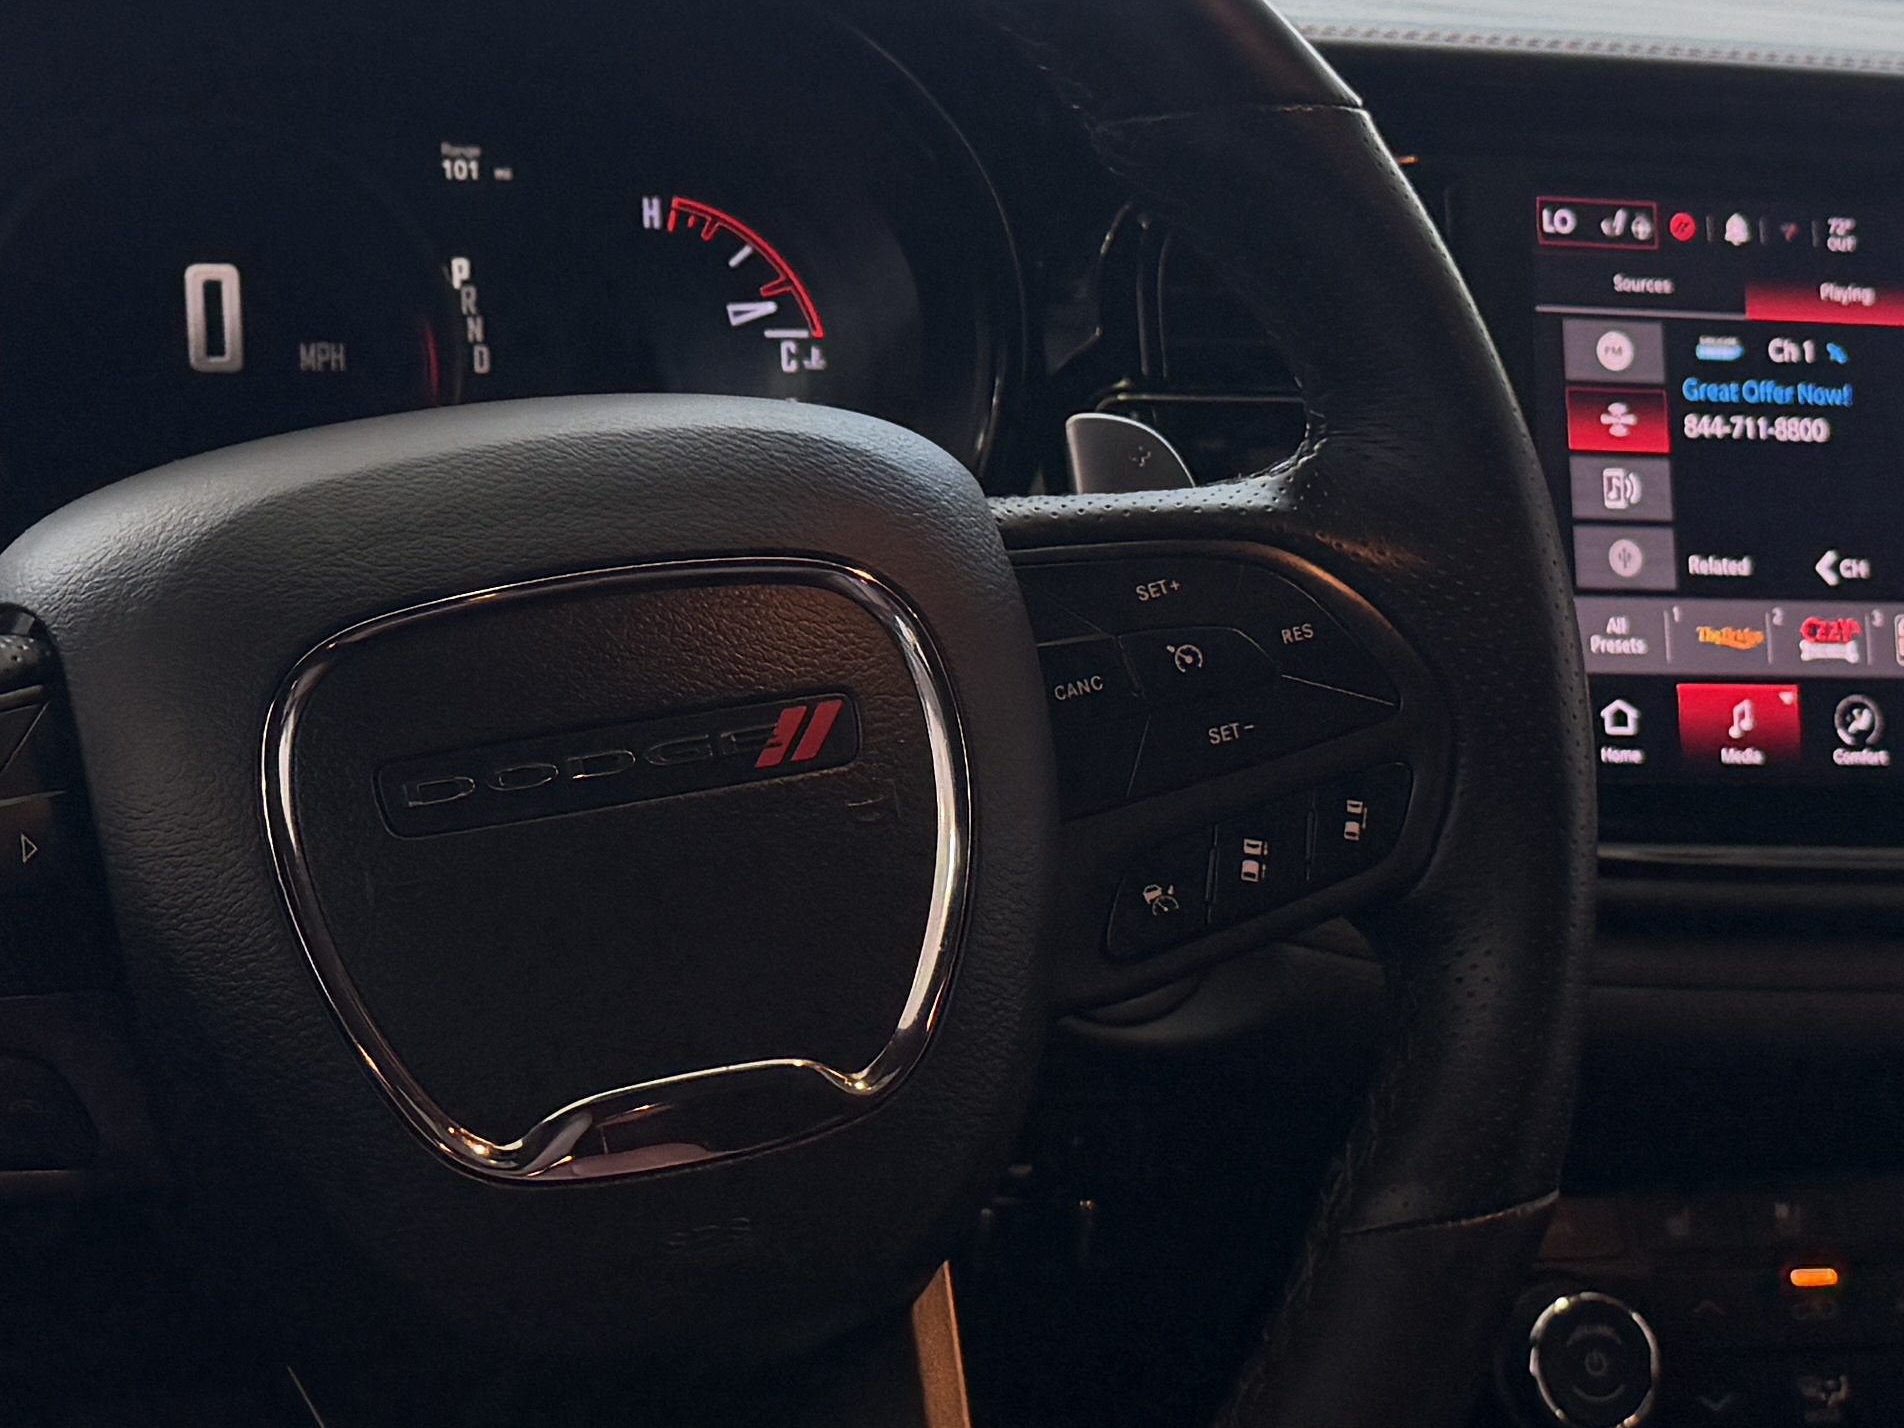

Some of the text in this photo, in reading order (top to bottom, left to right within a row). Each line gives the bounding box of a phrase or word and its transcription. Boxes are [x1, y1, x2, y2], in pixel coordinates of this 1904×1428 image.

[442, 159, 479, 181] 101
[642, 196, 661, 230] H
[1542, 207, 1577, 235] LO
[1612, 273, 1675, 295] Sources
[1819, 282, 1877, 307] Playing
[184, 263, 243, 372] 0
[300, 342, 346, 371] MPH
[781, 340, 799, 373] C
[1767, 336, 1801, 363] Ch
[1803, 339, 1816, 364] 1
[1682, 376, 1853, 408] Great Offer Now!
[1683, 413, 1831, 443] 844-711-8800
[1688, 554, 1753, 577] Related
[1839, 558, 1872, 579] CH
[1280, 622, 1315, 645] RES
[1606, 616, 1631, 635] All
[1590, 635, 1649, 655] Presets
[1054, 675, 1104, 701] CANC
[403, 723, 782, 808] DODGE
[1600, 746, 1644, 765] Home
[1720, 747, 1766, 766] Media
[1833, 747, 1890, 767] Comfort
